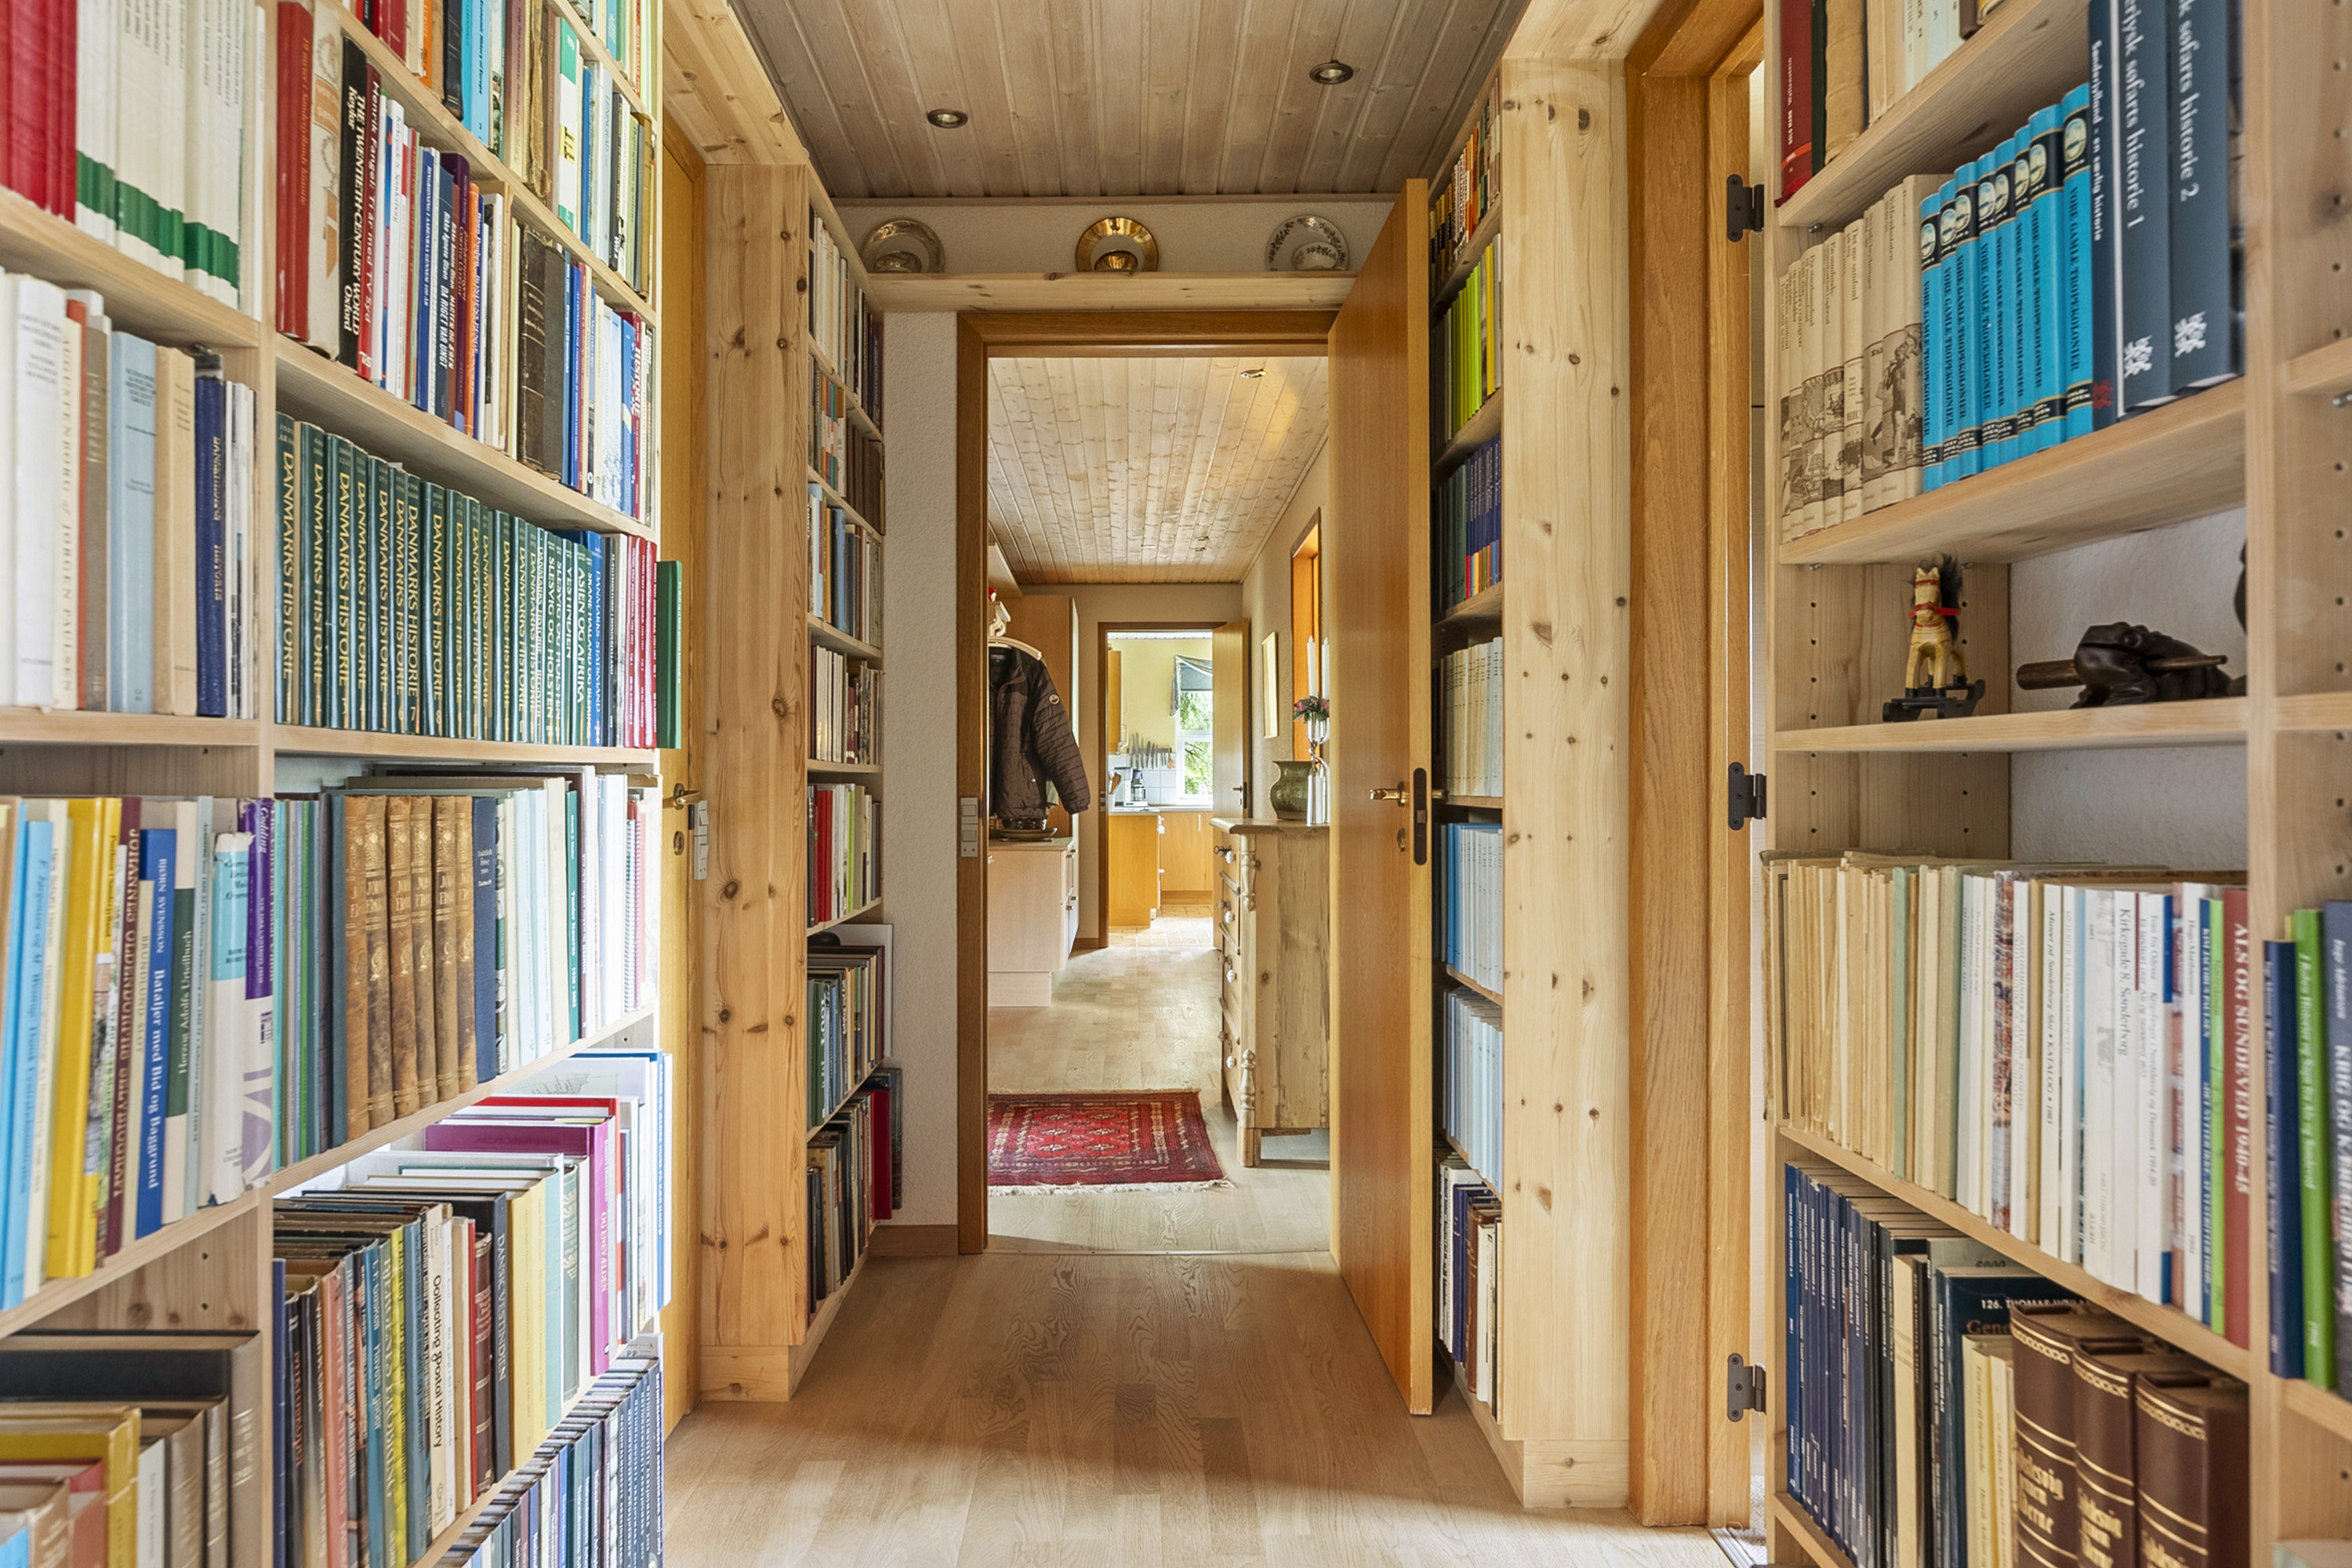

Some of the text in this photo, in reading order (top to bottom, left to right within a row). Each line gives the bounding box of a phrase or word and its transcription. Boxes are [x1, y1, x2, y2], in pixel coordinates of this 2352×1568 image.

[347, 85, 358, 130] Keylor
[370, 82, 380, 133] Henrik
[2125, 60, 2145, 129] søfarts
[2180, 20, 2201, 201] søfarts historie 2
[368, 136, 378, 189] Fangel:
[2092, 41, 2103, 241] Sønderjylland en særlig historie
[2126, 129, 2146, 211] historie
[368, 194, 376, 209] Ti
[368, 212, 376, 227] år
[366, 271, 373, 293] TV
[440, 299, 448, 325] RIGET
[441, 285, 448, 298] DA
[1980, 279, 1989, 315] GAMLE
[2069, 187, 2080, 372] VORE GAMLE TROPEKOLONIER
[439, 325, 448, 343] VAR
[439, 344, 448, 368] UNGT
[1982, 316, 1991, 410] TROPEKOLONIER
[1945, 337, 1954, 428] TROPEKOLONIER
[283, 452, 294, 679] DANMARKS HISTORIE
[314, 463, 324, 684] DANMARKS HISTORIE
[339, 472, 350, 687] DANMARKS HISTORIE
[358, 481, 366, 690] DANMARKS HISTORIE
[379, 489, 388, 691] DANMARKS HISTORIE
[433, 514, 443, 616] DANMARKS
[577, 568, 586, 613] ASIEN
[408, 505, 419, 721] DANMARKS HISTORIE 7
[548, 619, 555, 644] OG
[577, 618, 585, 641] OG
[433, 621, 443, 701] HISTORIE
[126, 828, 140, 922] JOHANNES
[2048, 944, 2055, 957] på
[2118, 909, 2131, 969] Kirkegade
[147, 858, 168, 1189] BJØRN SVENSSON Bataljer med Bid og Baggrund
[178, 931, 192, 1074] Herzog Adolfs Urteilbuch
[2118, 988, 2131, 1057] Sønderborg
[2234, 924, 2250, 1194] ALS OG SUNDEVED 1940-45
[2335, 1044, 2352, 1094] KRIG
[2336, 1098, 2352, 1128] OG
[383, 1259, 393, 1377] BJERGENES
[1981, 1299, 2002, 1309] 126.
[431, 1275, 444, 1449] Collecting Postal History
